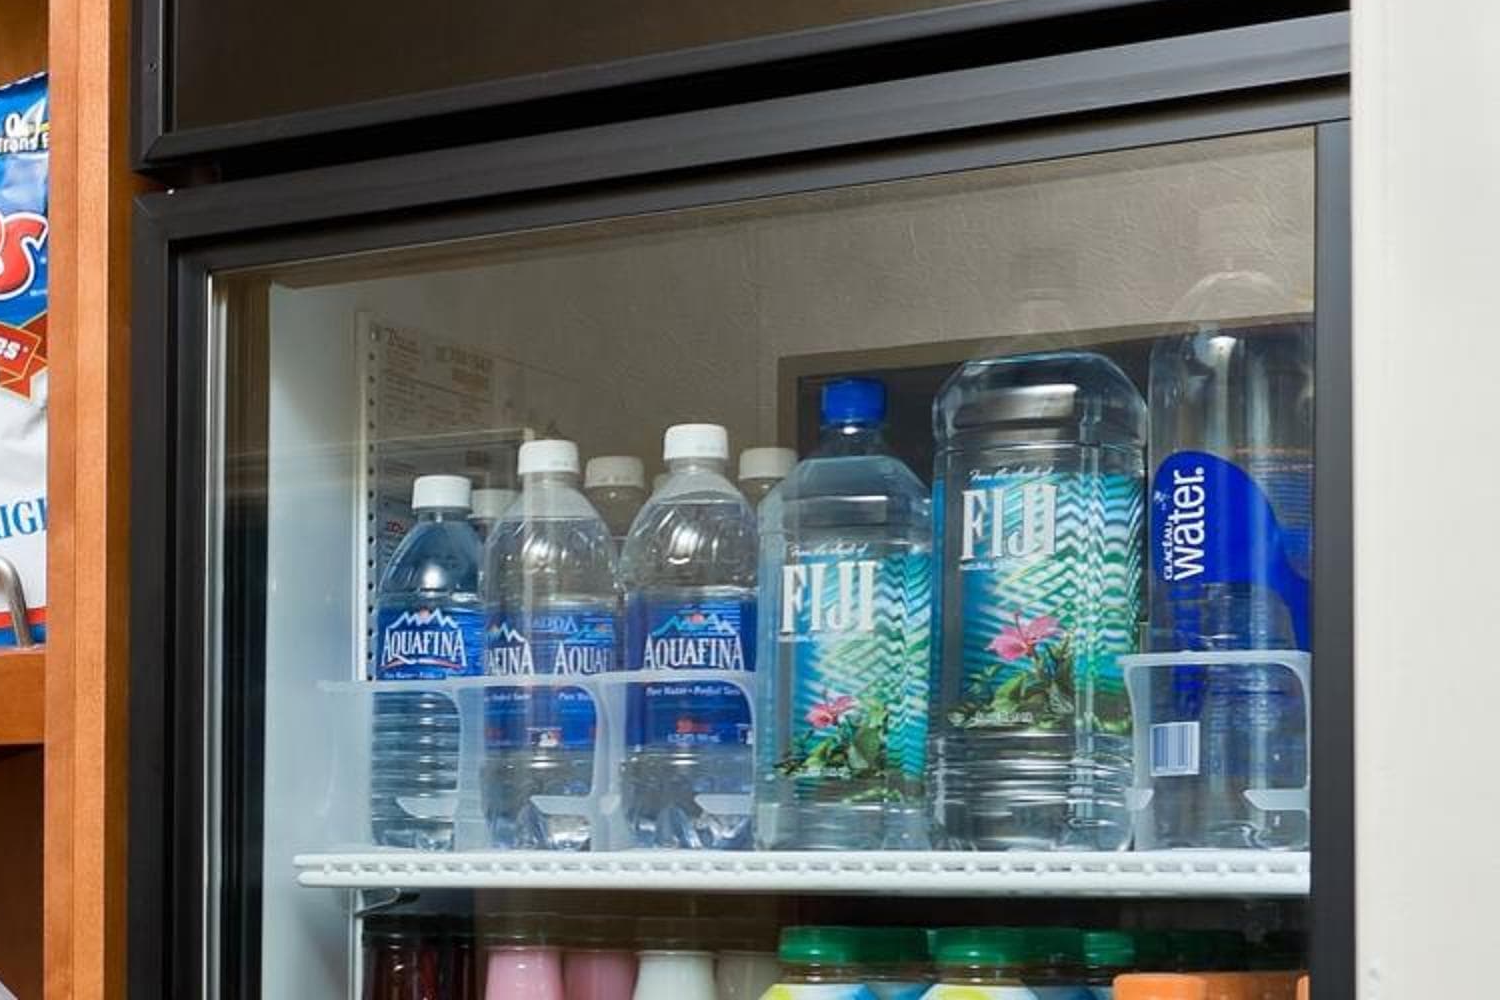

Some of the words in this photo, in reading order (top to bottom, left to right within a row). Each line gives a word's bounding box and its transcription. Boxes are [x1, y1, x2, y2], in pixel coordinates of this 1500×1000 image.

[960, 484, 1059, 561] FIJI
[780, 561, 878, 634] FIJI
[381, 627, 466, 667] AQUAFINA
[642, 632, 745, 673] AQUAFINA
